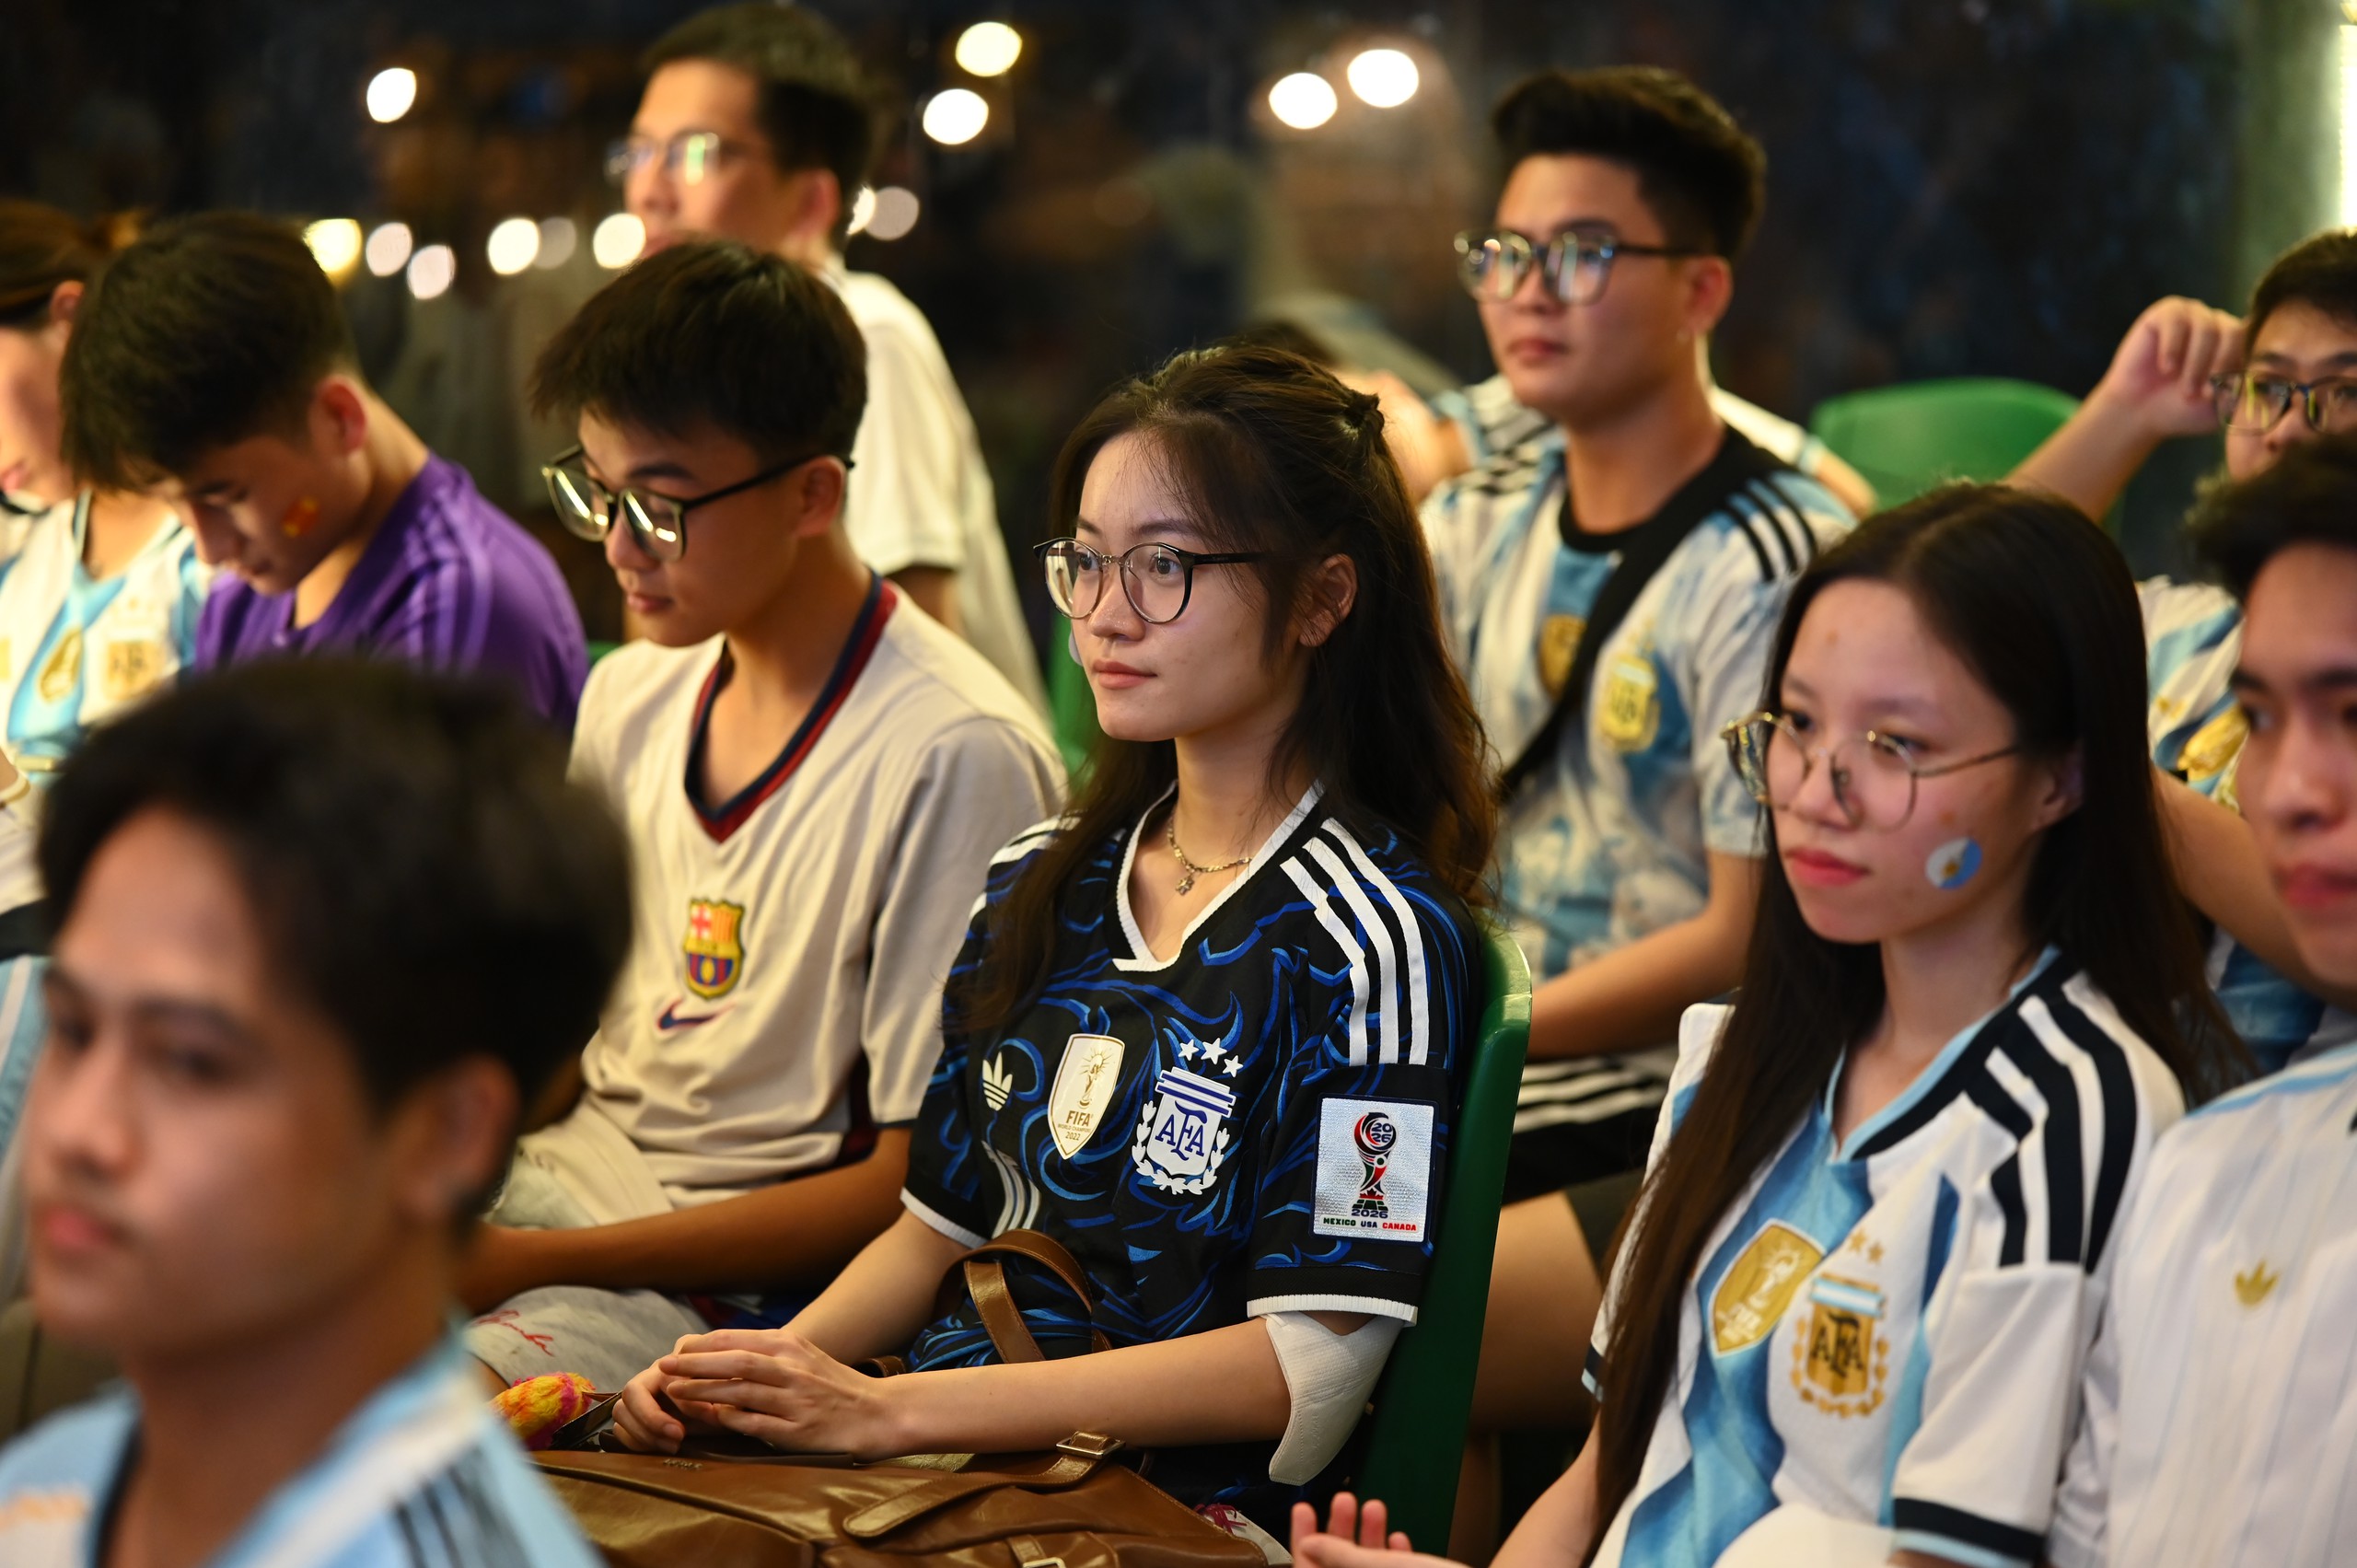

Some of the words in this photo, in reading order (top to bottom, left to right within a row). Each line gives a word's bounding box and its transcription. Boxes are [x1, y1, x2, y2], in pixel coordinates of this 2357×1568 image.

[1066, 1110, 1091, 1127] FIFA
[1155, 1100, 1208, 1161] AFA
[1371, 1122, 1393, 1132] 20
[1065, 1132, 1081, 1141] 2022
[1371, 1132, 1392, 1144] 26
[1351, 1209, 1388, 1219] 2026
[1323, 1217, 1356, 1226] MEXICO
[1382, 1222, 1417, 1231] CANADA
